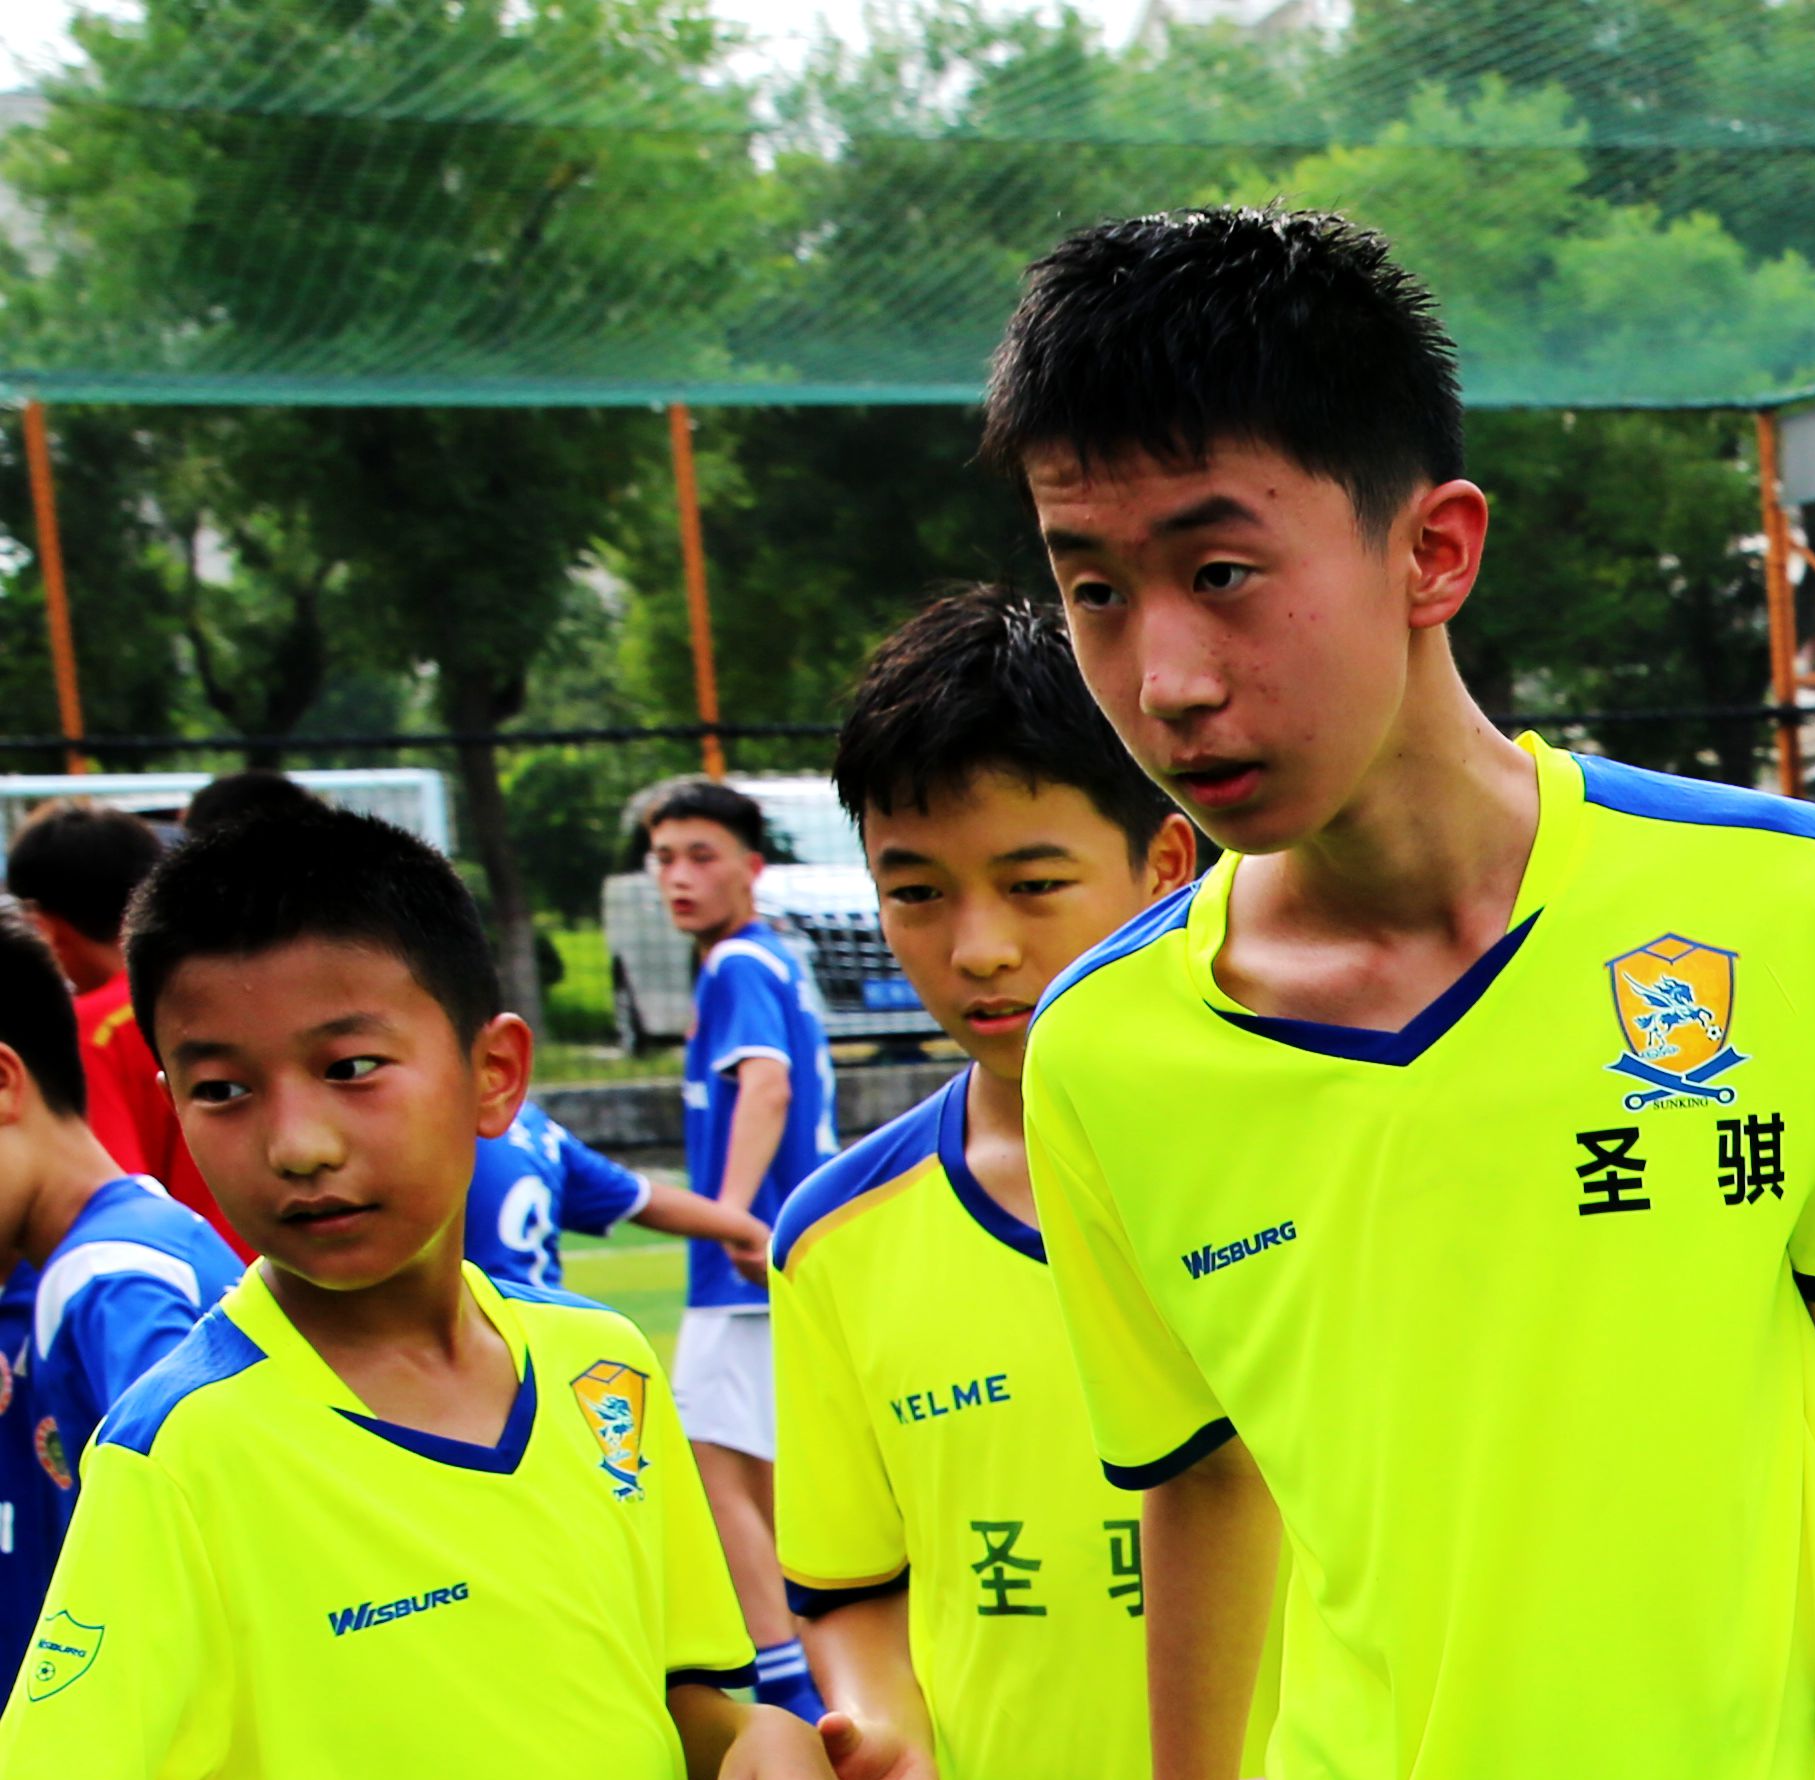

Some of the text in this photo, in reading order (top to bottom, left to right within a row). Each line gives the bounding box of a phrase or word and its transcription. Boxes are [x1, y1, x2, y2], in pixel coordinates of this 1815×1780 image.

[1653, 1096, 1709, 1110] SUNKING
[1181, 1219, 1297, 1280] WISBURG
[327, 1581, 470, 1637] WISBURG
